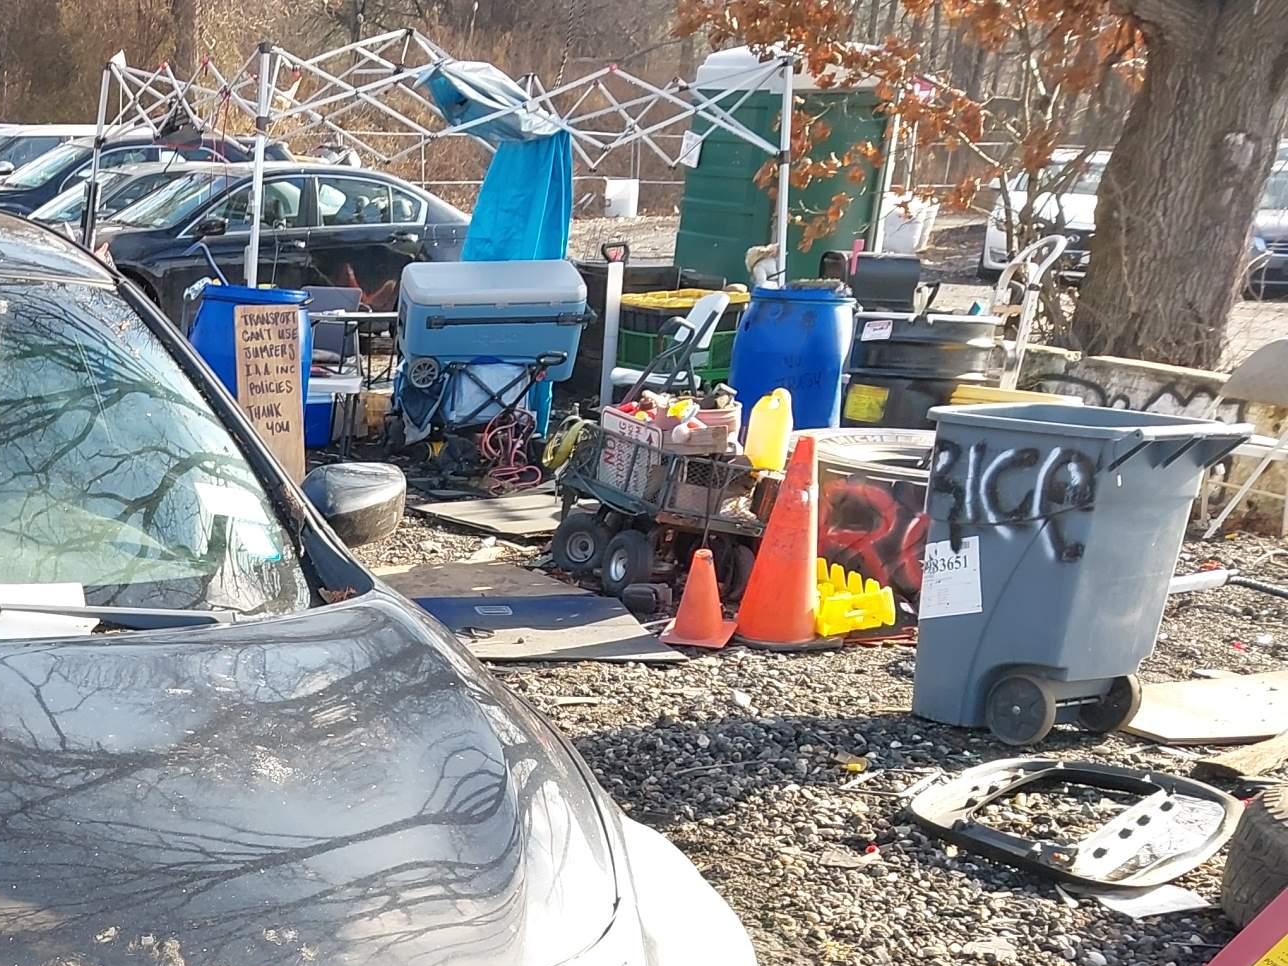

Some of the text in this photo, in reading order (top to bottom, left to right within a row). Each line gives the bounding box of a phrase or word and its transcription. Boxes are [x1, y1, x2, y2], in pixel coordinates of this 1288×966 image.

[241, 311, 296, 326] TRANSPORT
[277, 327, 297, 340] USE
[243, 343, 295, 360] JUMPERS
[276, 365, 295, 374] INC
[247, 403, 281, 420] THANK
[266, 421, 290, 436] YOU
